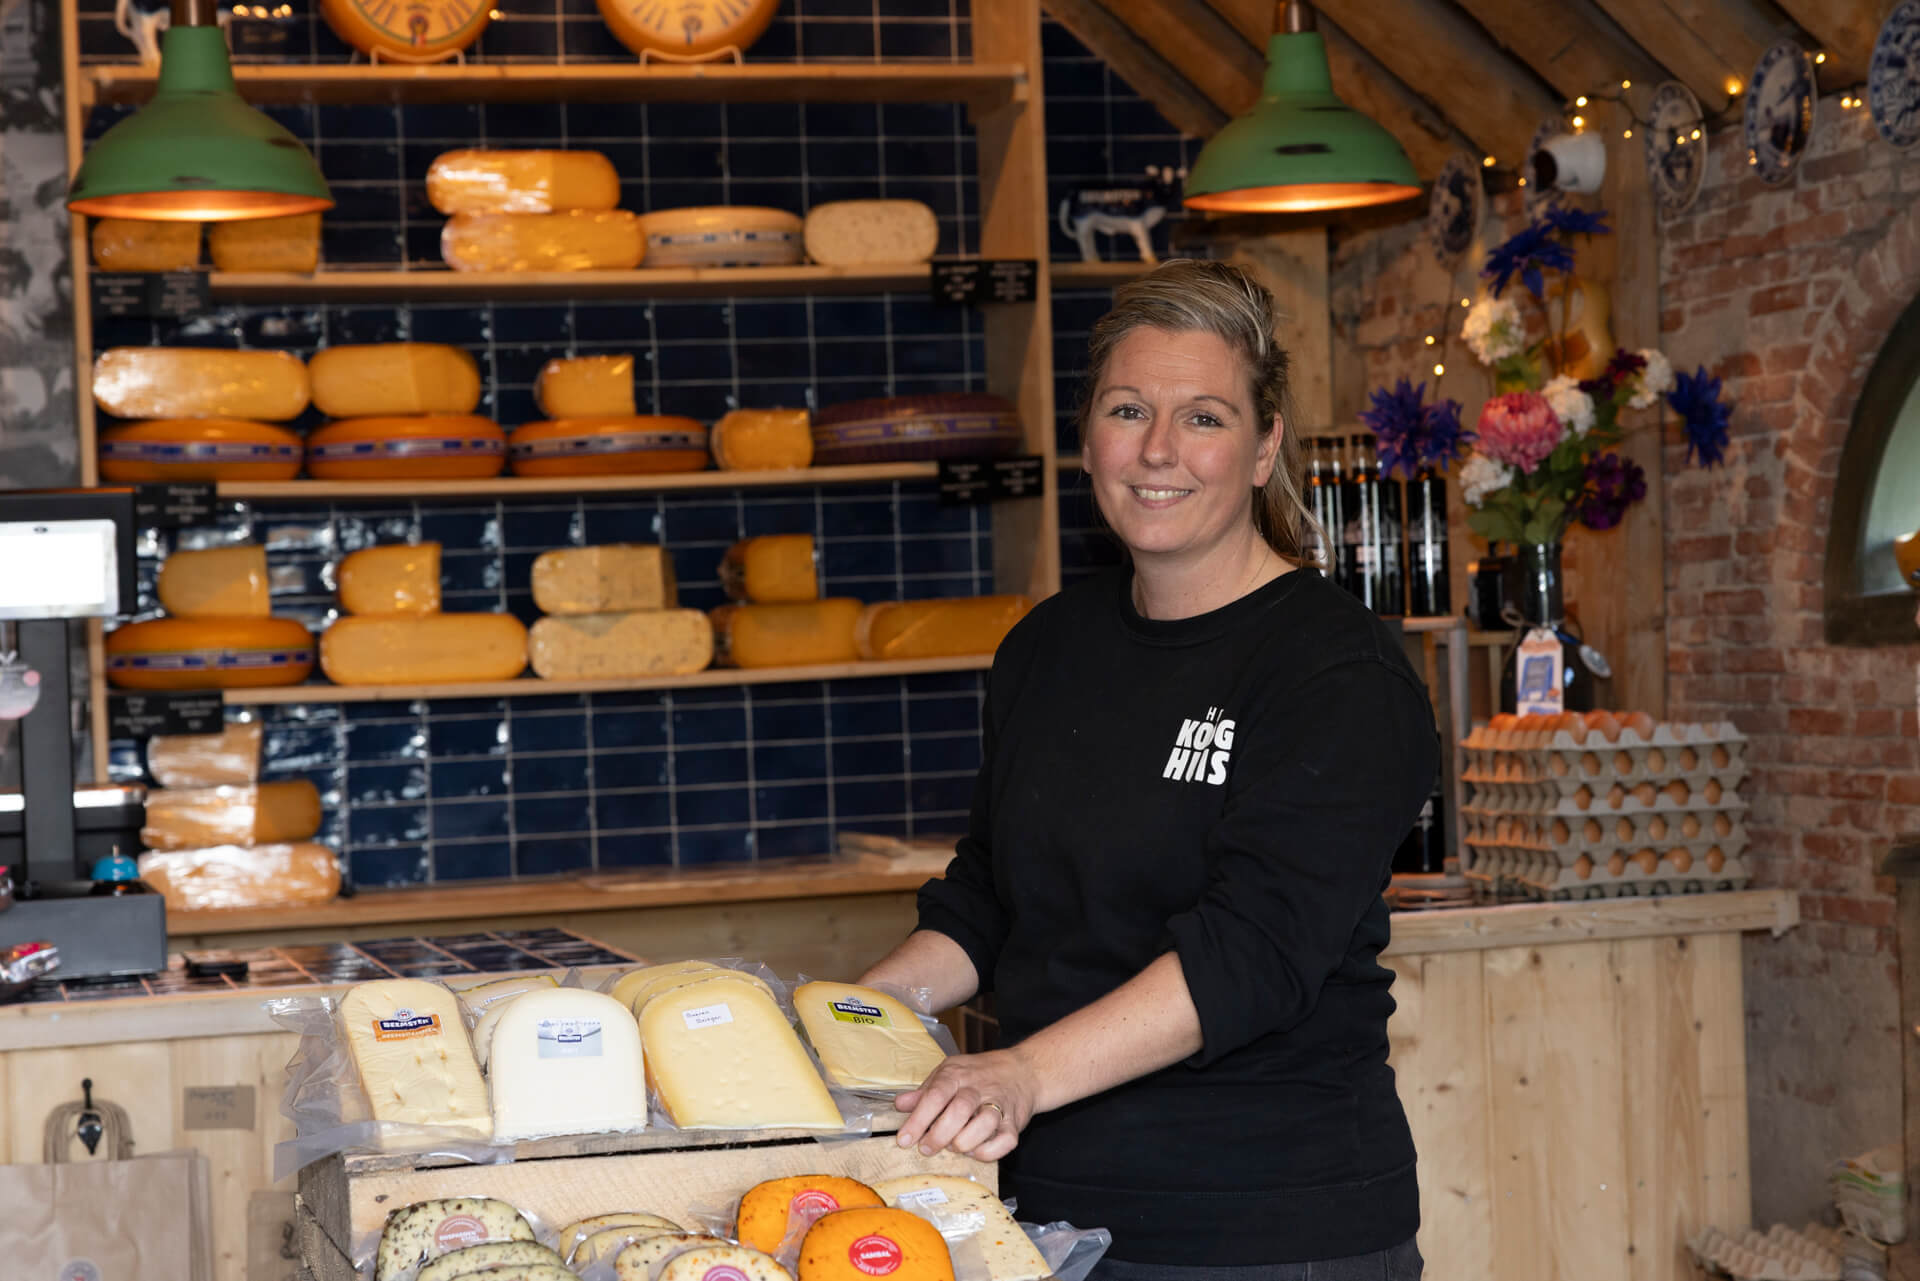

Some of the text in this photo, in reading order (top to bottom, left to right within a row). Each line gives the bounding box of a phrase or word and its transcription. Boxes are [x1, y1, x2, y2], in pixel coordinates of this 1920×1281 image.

[836, 1003, 879, 1015] BEEMSTER
[382, 1018, 430, 1028] BEEMSTER
[852, 1016, 876, 1025] BIO
